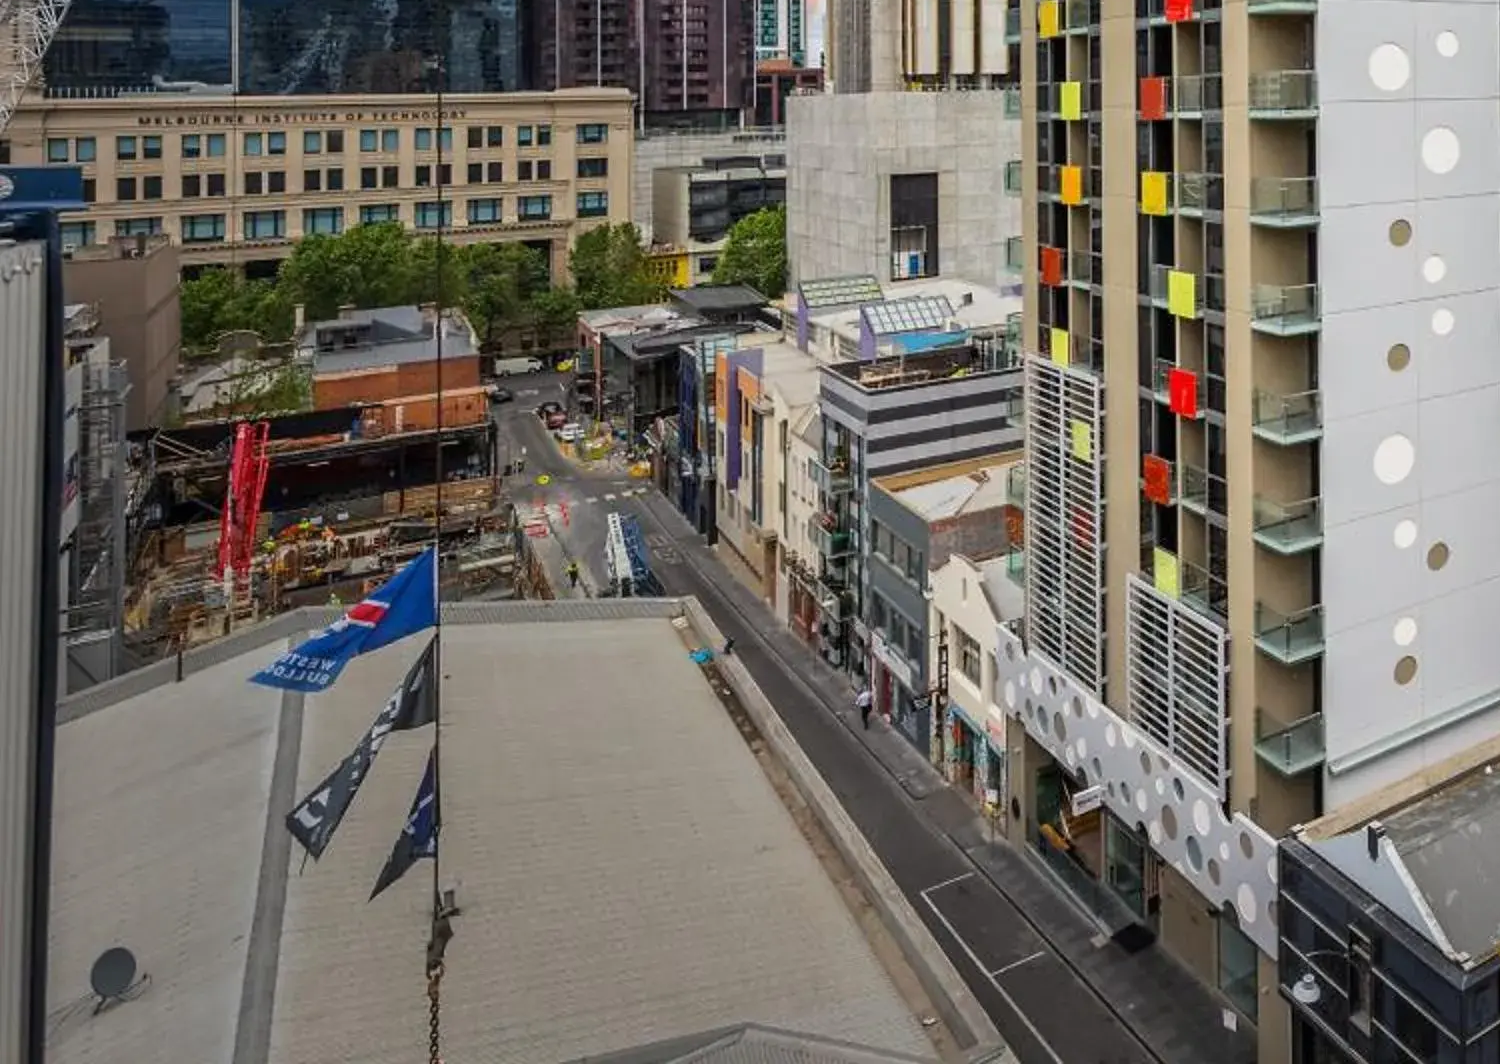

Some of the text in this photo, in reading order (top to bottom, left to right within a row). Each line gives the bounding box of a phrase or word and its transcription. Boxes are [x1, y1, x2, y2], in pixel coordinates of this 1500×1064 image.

[138, 110, 468, 126] MELBOURNE INSTITUTE OF TECHNOLOGY
